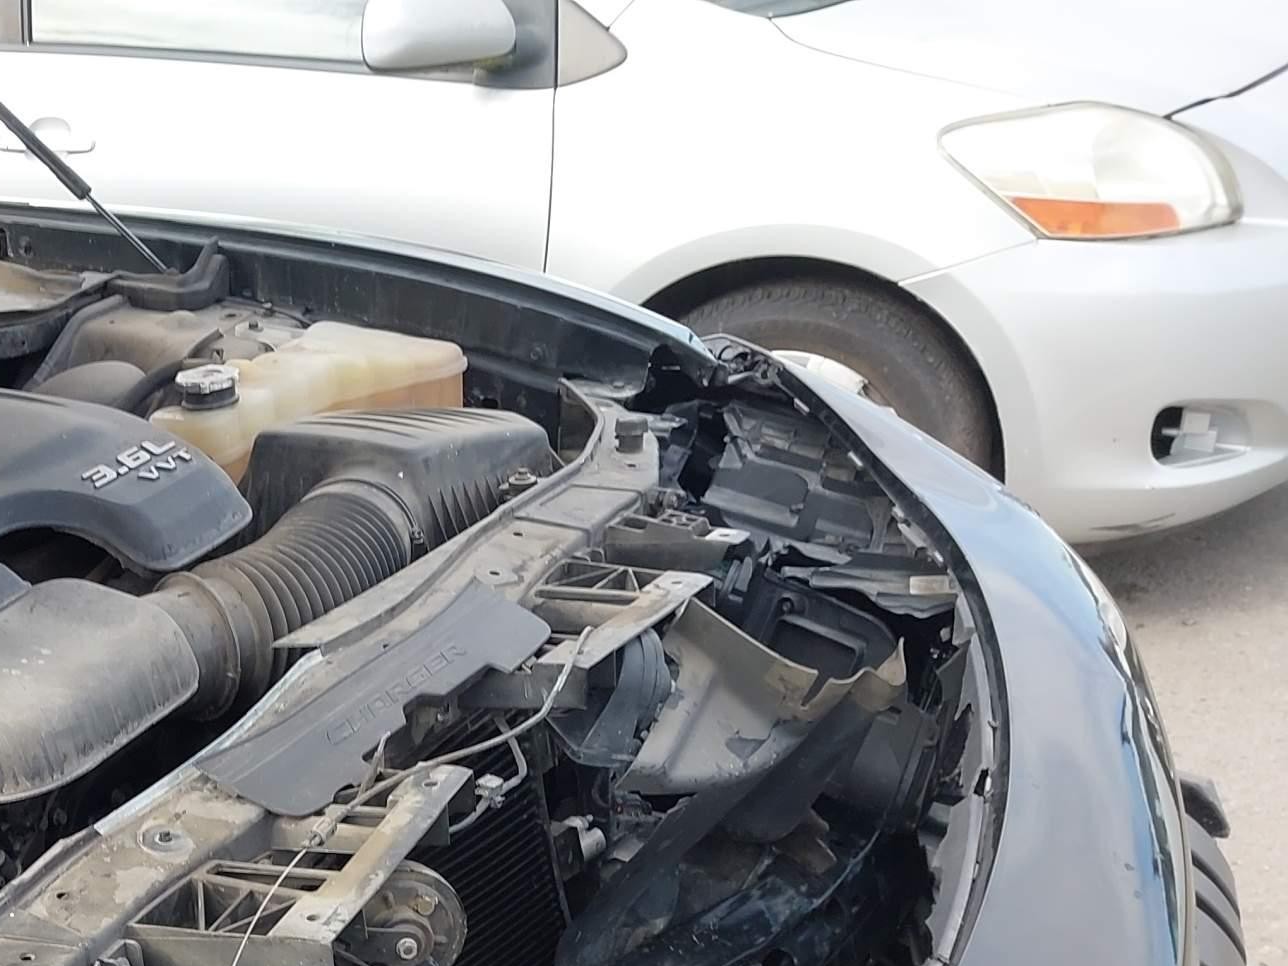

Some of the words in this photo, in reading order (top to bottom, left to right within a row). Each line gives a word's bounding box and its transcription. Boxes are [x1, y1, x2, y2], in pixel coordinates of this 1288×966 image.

[81, 439, 176, 489] 3.6L
[137, 447, 193, 482] VVT
[325, 644, 468, 746] CHARGER
